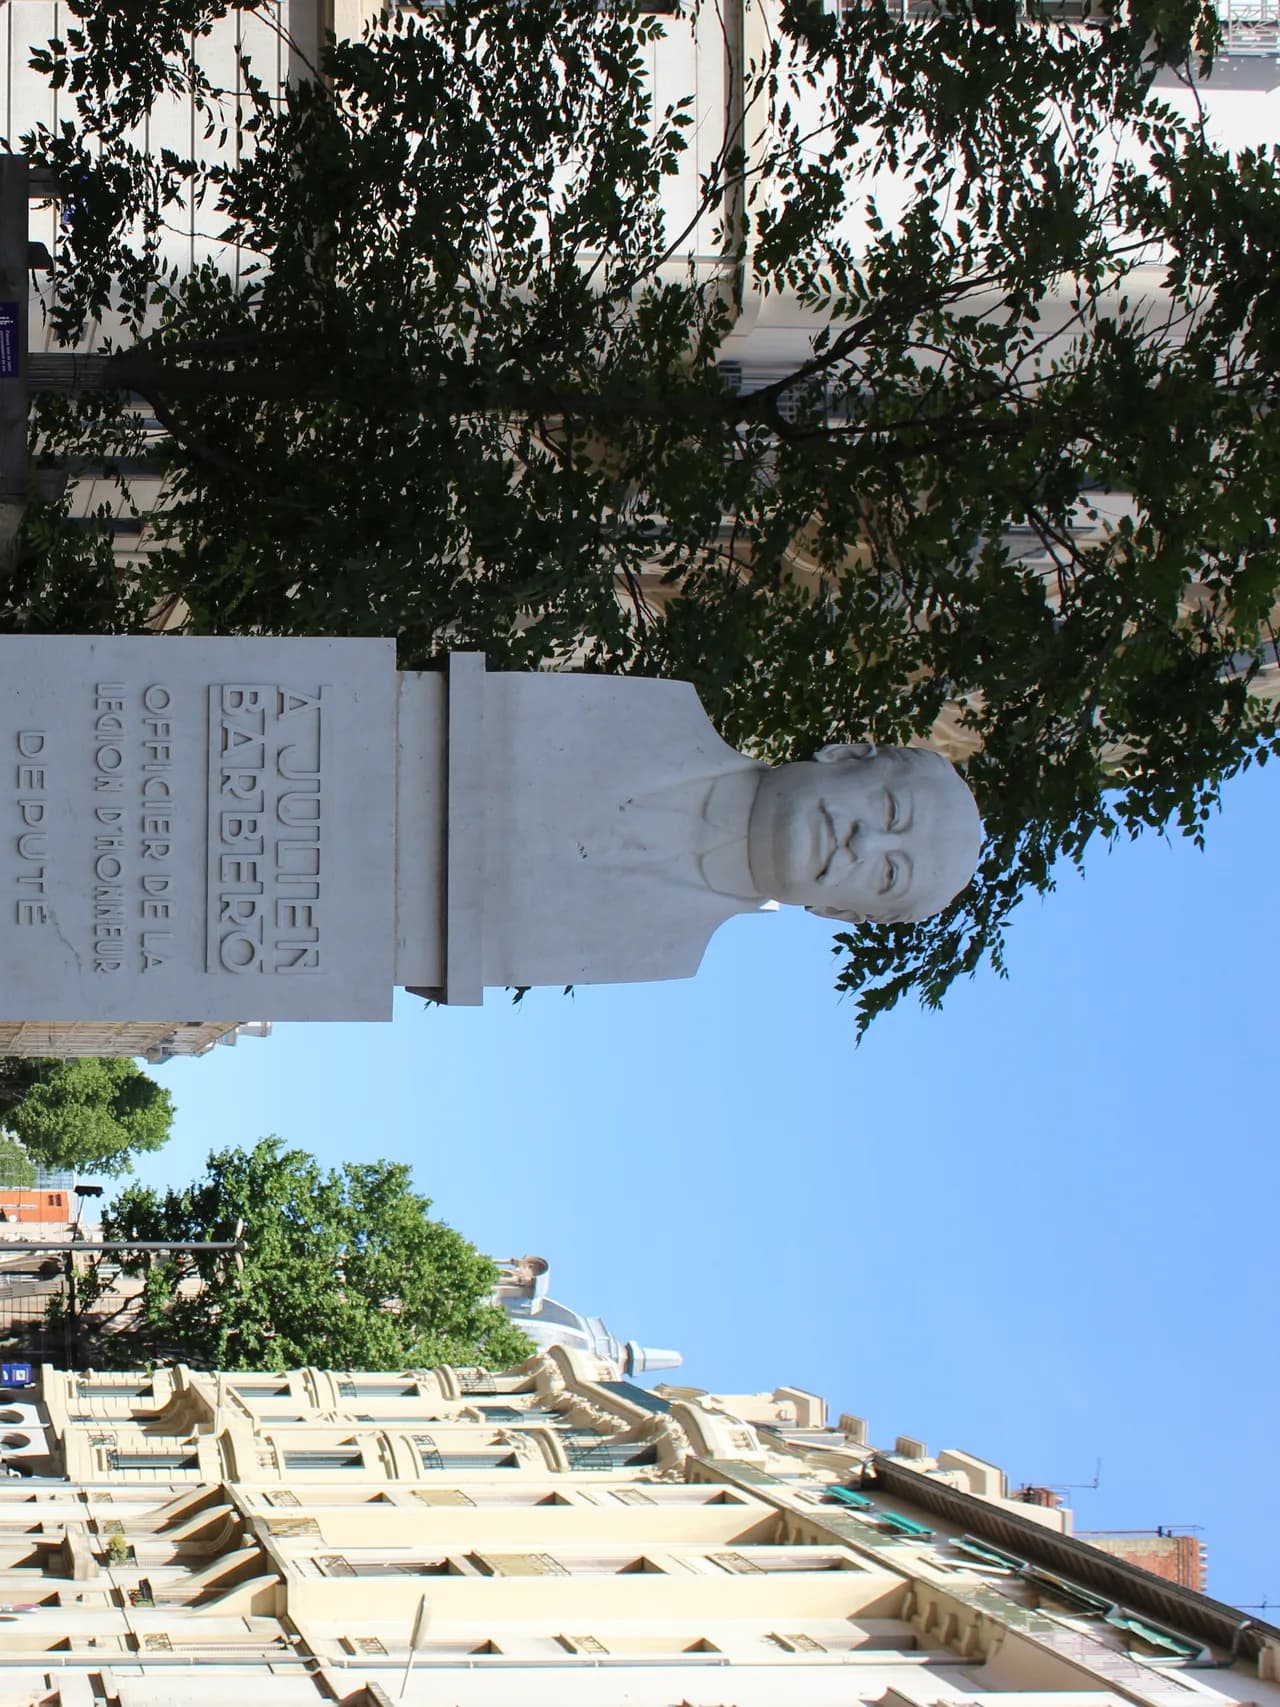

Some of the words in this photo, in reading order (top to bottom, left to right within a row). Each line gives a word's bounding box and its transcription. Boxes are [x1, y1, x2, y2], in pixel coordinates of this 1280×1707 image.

[95, 682, 128, 793] LEGION
[277, 685, 323, 721] A
[142, 684, 173, 862] OFFICIER
[220, 685, 266, 975] BARBERO
[94, 807, 128, 975] D'HONNEUR
[142, 875, 173, 919] DE
[276, 744, 323, 975] JULIEN
[141, 932, 173, 974] LA
